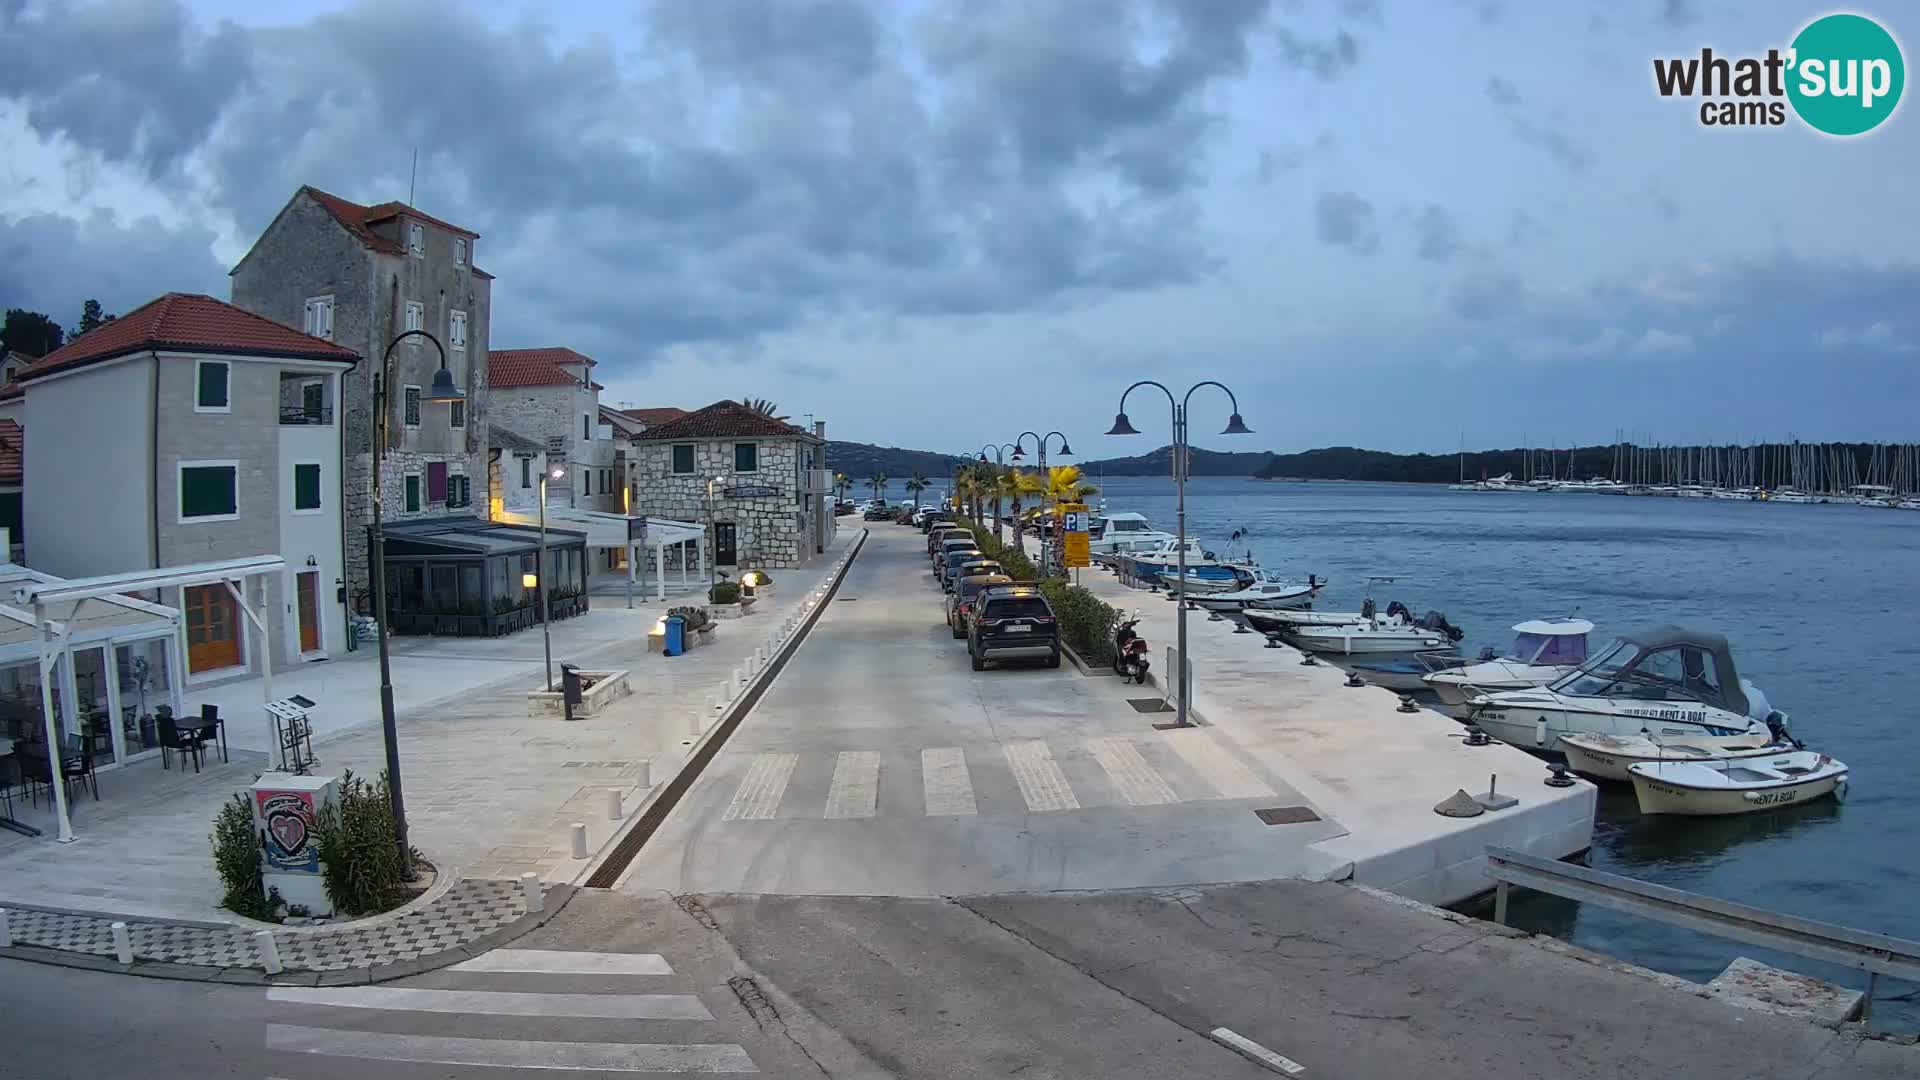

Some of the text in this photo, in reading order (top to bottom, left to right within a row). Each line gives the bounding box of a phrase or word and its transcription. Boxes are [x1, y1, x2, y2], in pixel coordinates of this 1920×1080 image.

[1066, 514, 1076, 529] P
[1659, 709, 1681, 720] RENT
[1681, 710, 1686, 721] A
[1687, 711, 1707, 723] BOAT
[1779, 790, 1798, 802] BOAT
